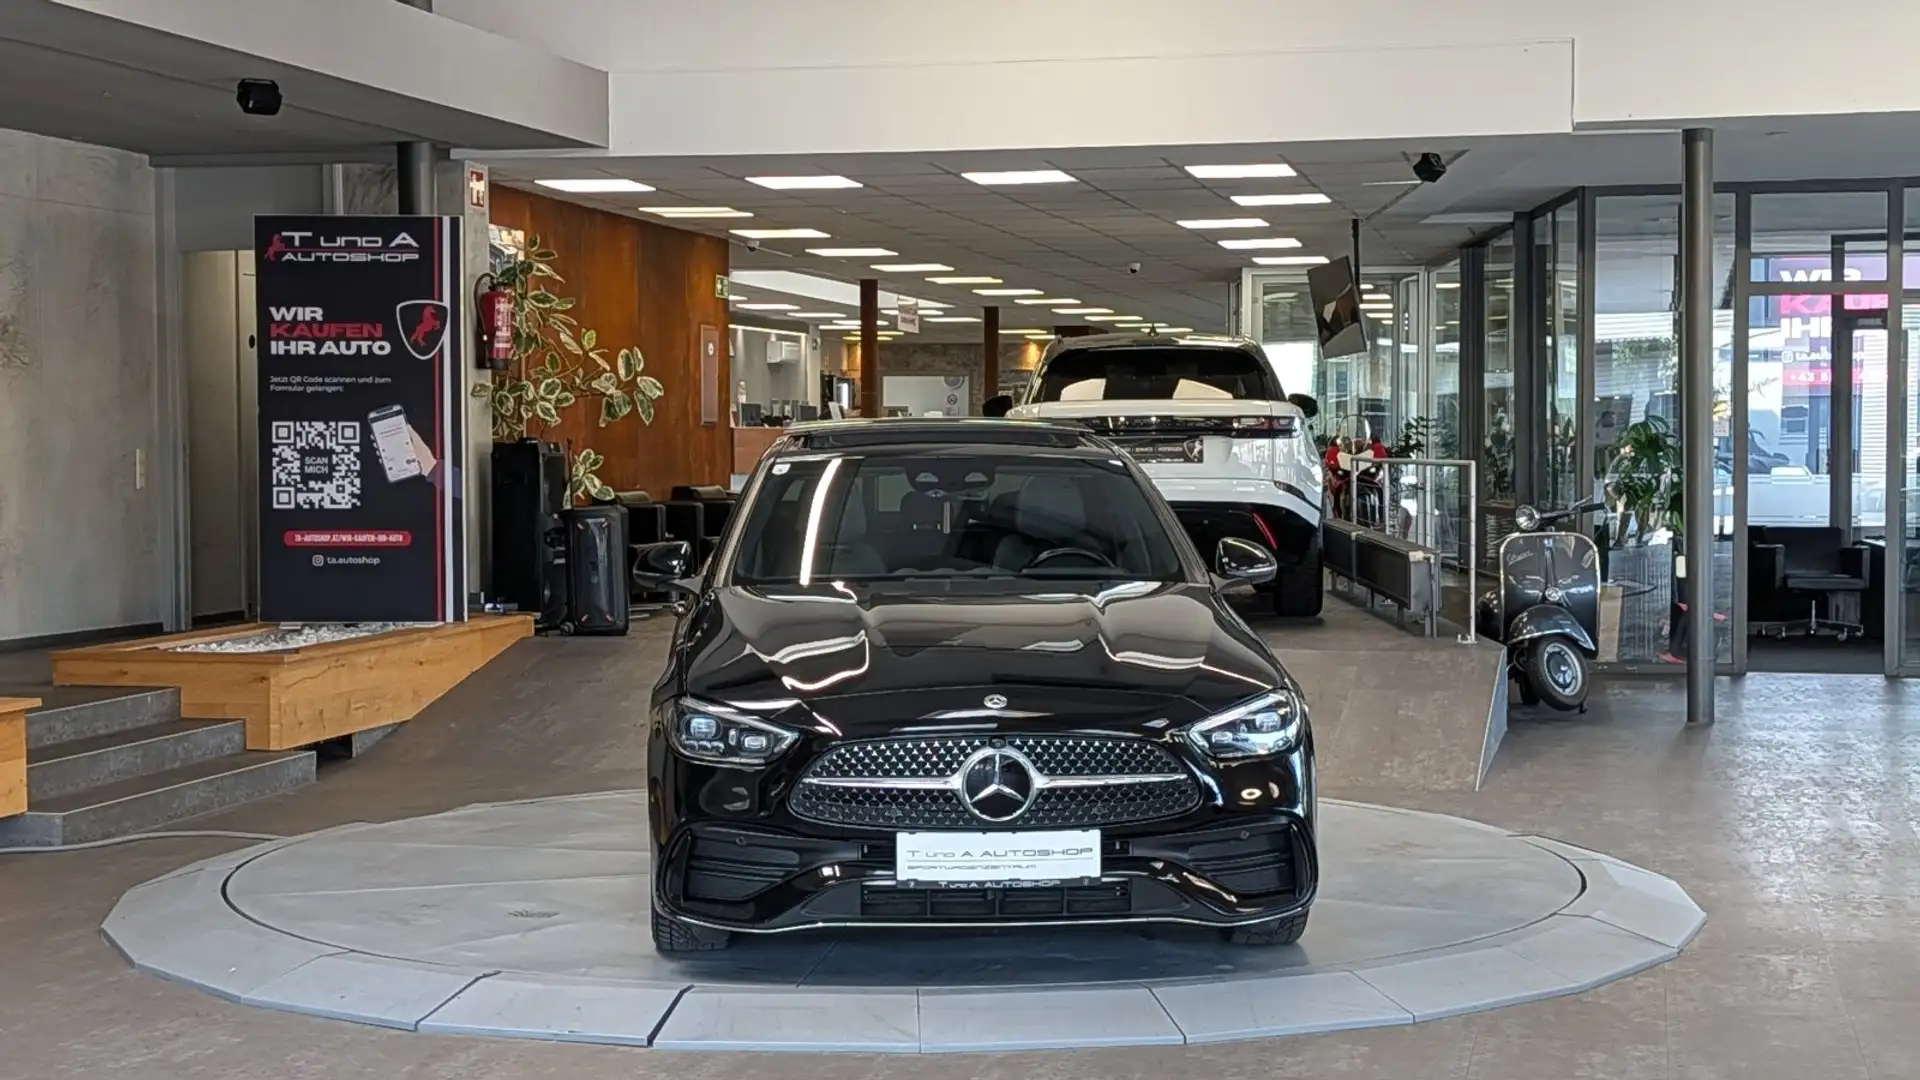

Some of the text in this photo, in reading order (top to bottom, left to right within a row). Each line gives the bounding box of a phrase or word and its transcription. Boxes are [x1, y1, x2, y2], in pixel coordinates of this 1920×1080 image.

[281, 232, 312, 246] T
[389, 232, 419, 247] A
[281, 252, 419, 262] AUTOSHOP
[269, 306, 323, 321] WIR
[270, 323, 383, 338] KAUFEN
[270, 341, 391, 355] IHR AUTO
[269, 375, 288, 383] Jetzt
[290, 375, 302, 384] QR
[303, 375, 323, 383] Code
[358, 375, 373, 383] und
[269, 384, 304, 392] Formular
[304, 456, 328, 465] SCAN
[304, 466, 328, 474] MICH
[327, 556, 381, 566] ta.autoshop
[960, 850, 974, 858] A
[980, 847, 1093, 857] AUTOSHOP
[938, 881, 949, 889] T
[968, 881, 979, 889] A
[984, 879, 1061, 889] AUTOSHOP
